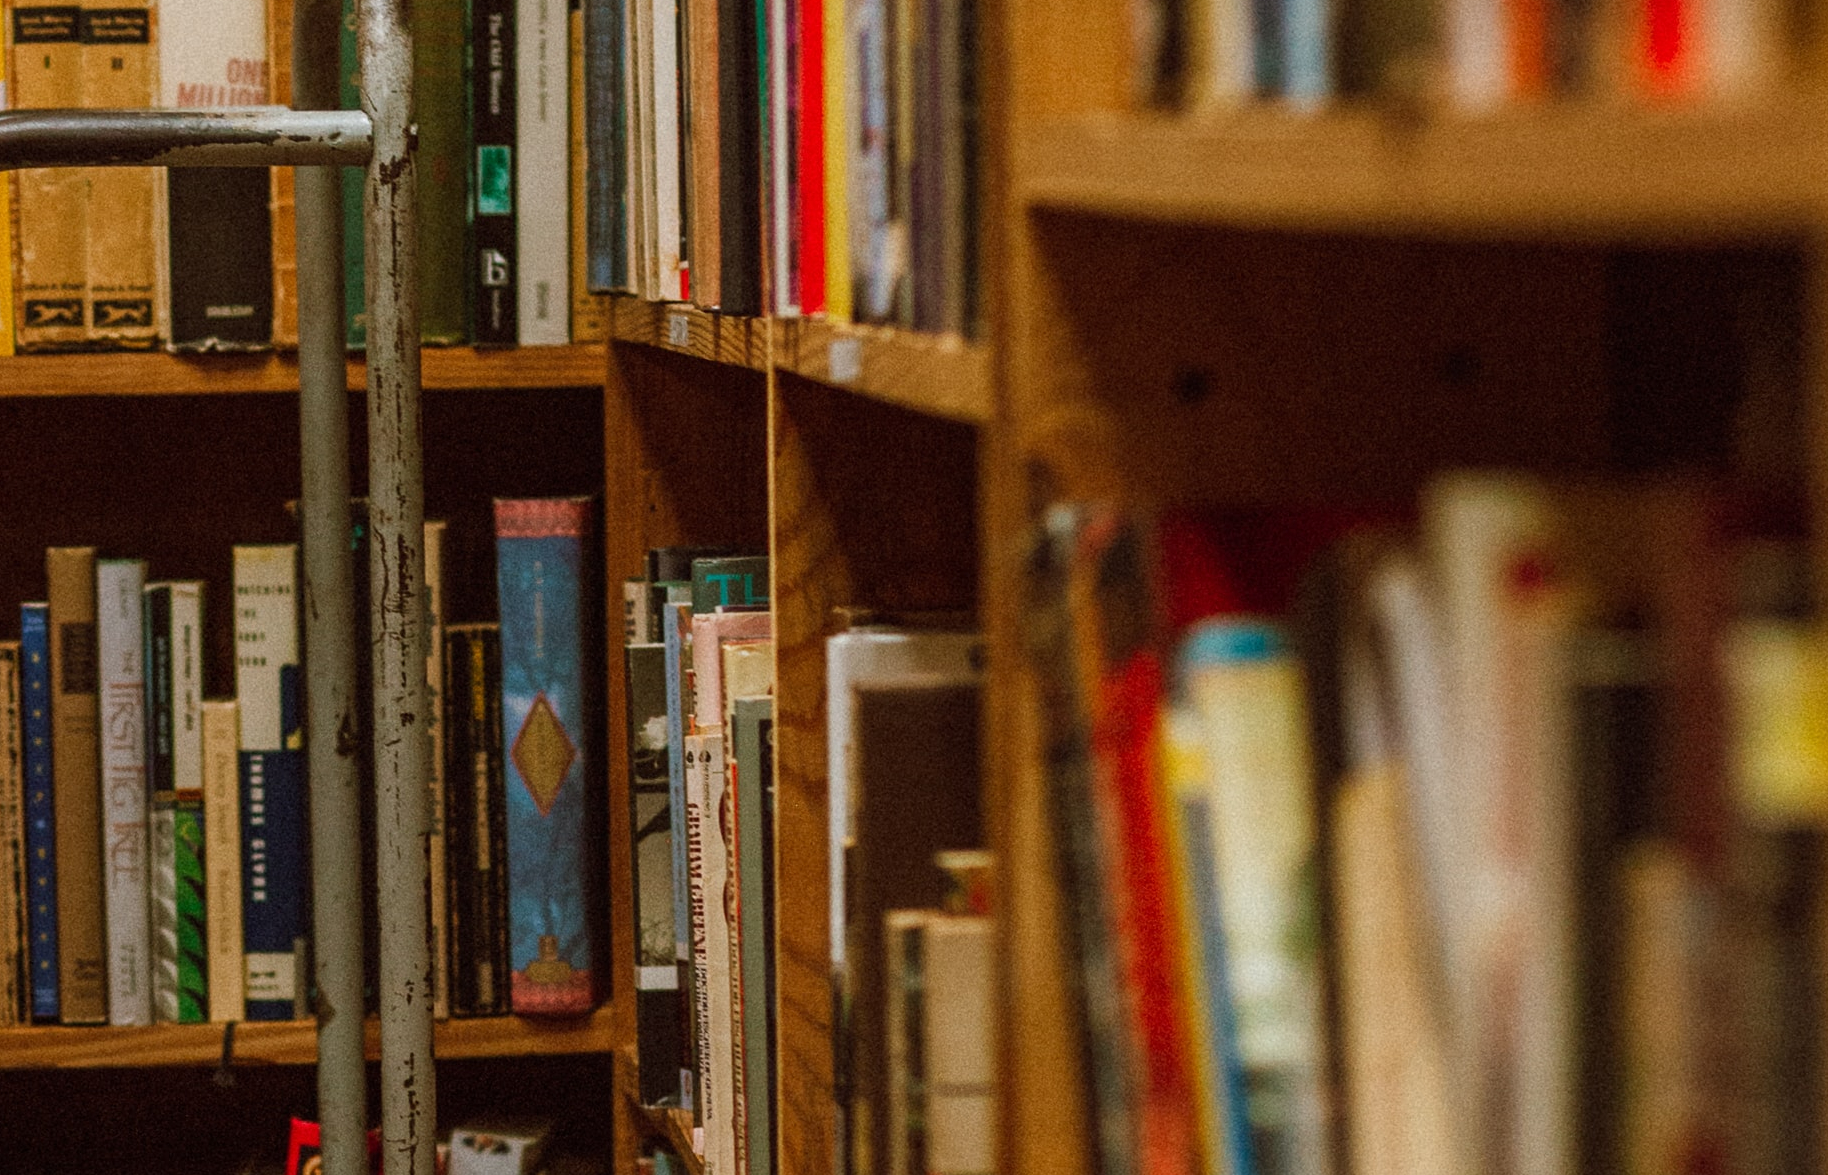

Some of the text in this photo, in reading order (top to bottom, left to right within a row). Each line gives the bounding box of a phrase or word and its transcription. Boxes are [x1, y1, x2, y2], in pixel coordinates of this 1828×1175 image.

[109, 681, 145, 755] FIRST
[685, 802, 707, 961] GRAHAM GREENE
